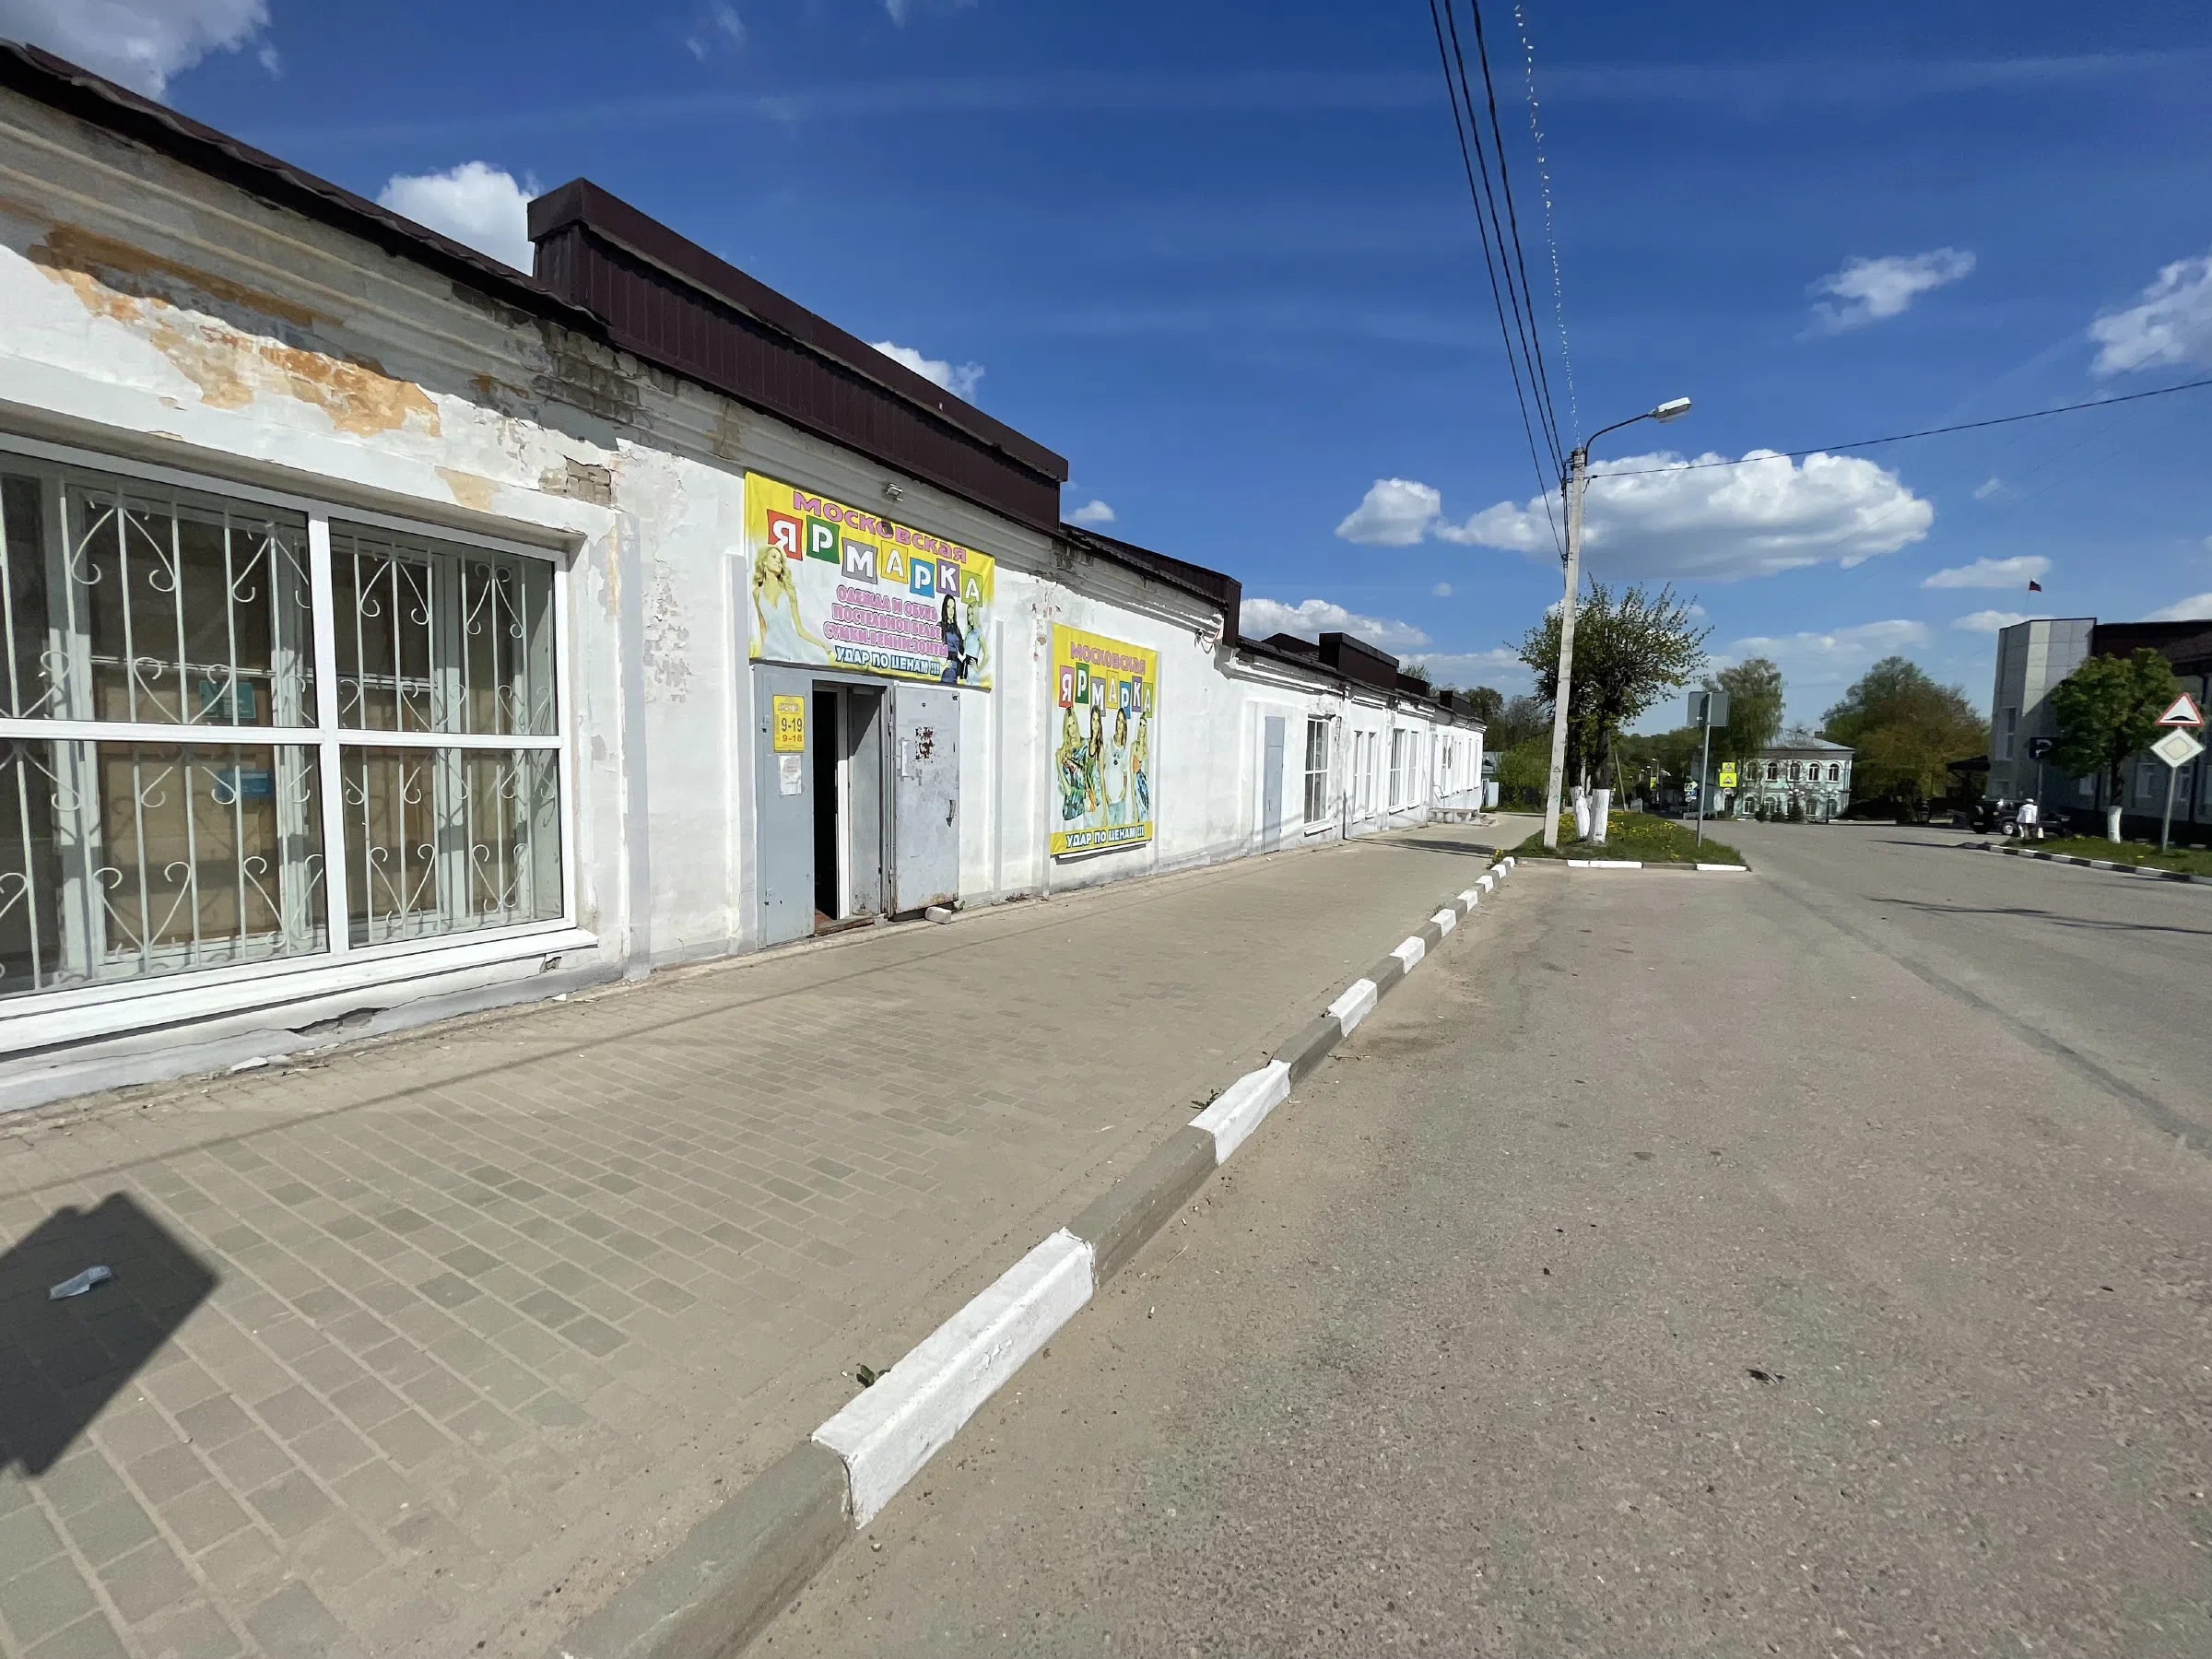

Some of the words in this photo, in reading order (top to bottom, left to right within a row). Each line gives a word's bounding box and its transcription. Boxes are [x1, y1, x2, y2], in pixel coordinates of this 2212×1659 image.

[771, 519, 980, 602] ЯРМАРКА
[831, 603, 911, 634] ПОСТЕЛЬНОЕ
[911, 619, 942, 641] БЕЛЬЕ
[837, 584, 891, 612] ОДЕЖДА
[891, 597, 902, 615] И
[903, 601, 938, 622] ОБУВЬ
[835, 645, 870, 665] УДАР
[871, 652, 889, 668] ПО
[890, 654, 929, 675] ЦЕНАМ
[1062, 669, 1151, 712] ЯРМАРКА
[782, 717, 803, 732] 9-19
[1065, 832, 1092, 849] УДАР
[1093, 830, 1107, 845] ПО
[1108, 827, 1135, 842] ЦЕНАМ
